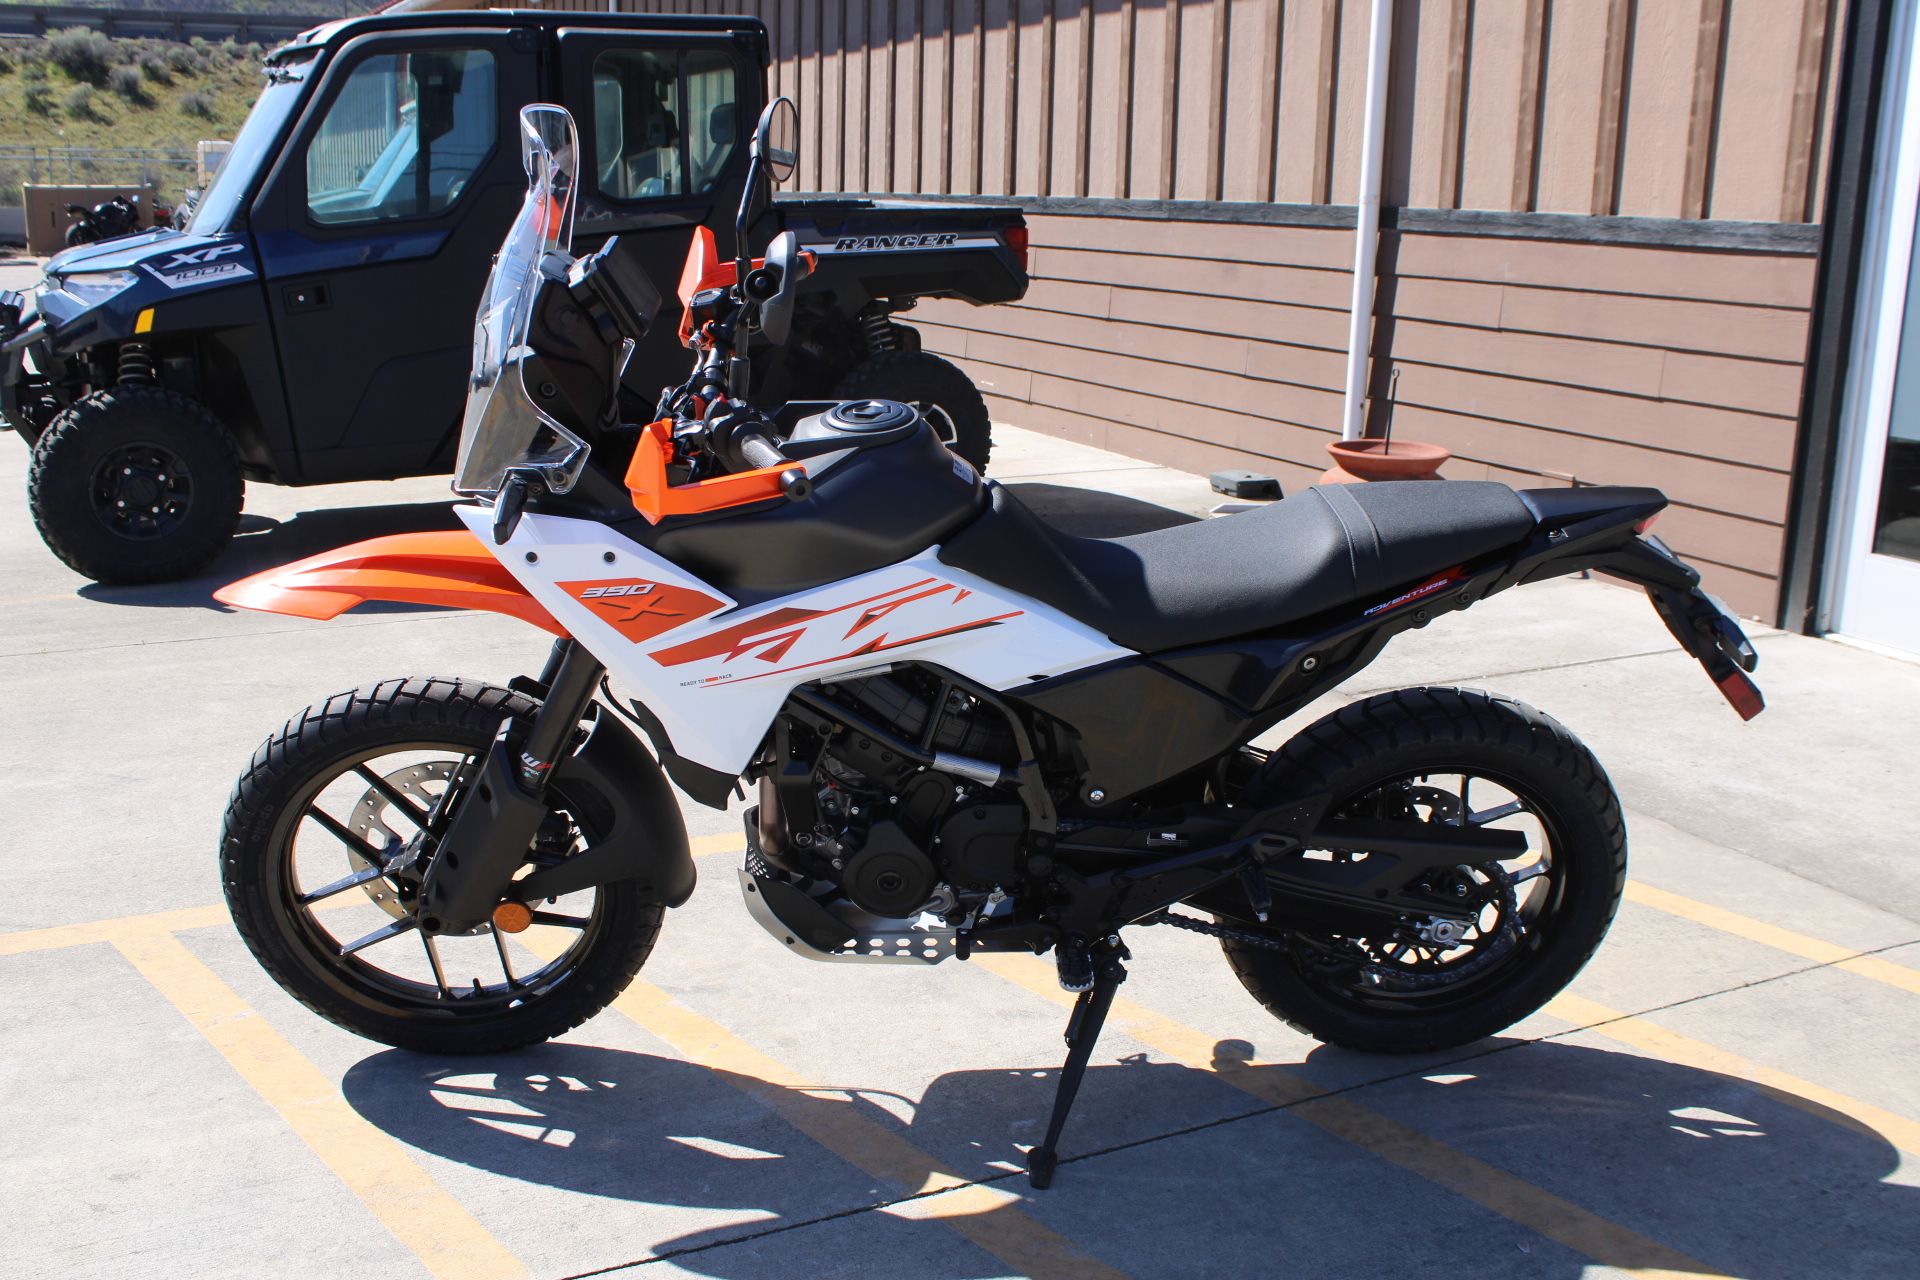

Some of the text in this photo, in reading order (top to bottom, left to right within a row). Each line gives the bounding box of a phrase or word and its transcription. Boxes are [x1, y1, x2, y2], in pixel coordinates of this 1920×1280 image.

[834, 232, 959, 252] RANGER
[161, 243, 245, 269] XP
[175, 263, 238, 280] 1000
[579, 583, 657, 599] 390
[1363, 578, 1449, 616] ADVENTURE
[596, 594, 686, 623] X
